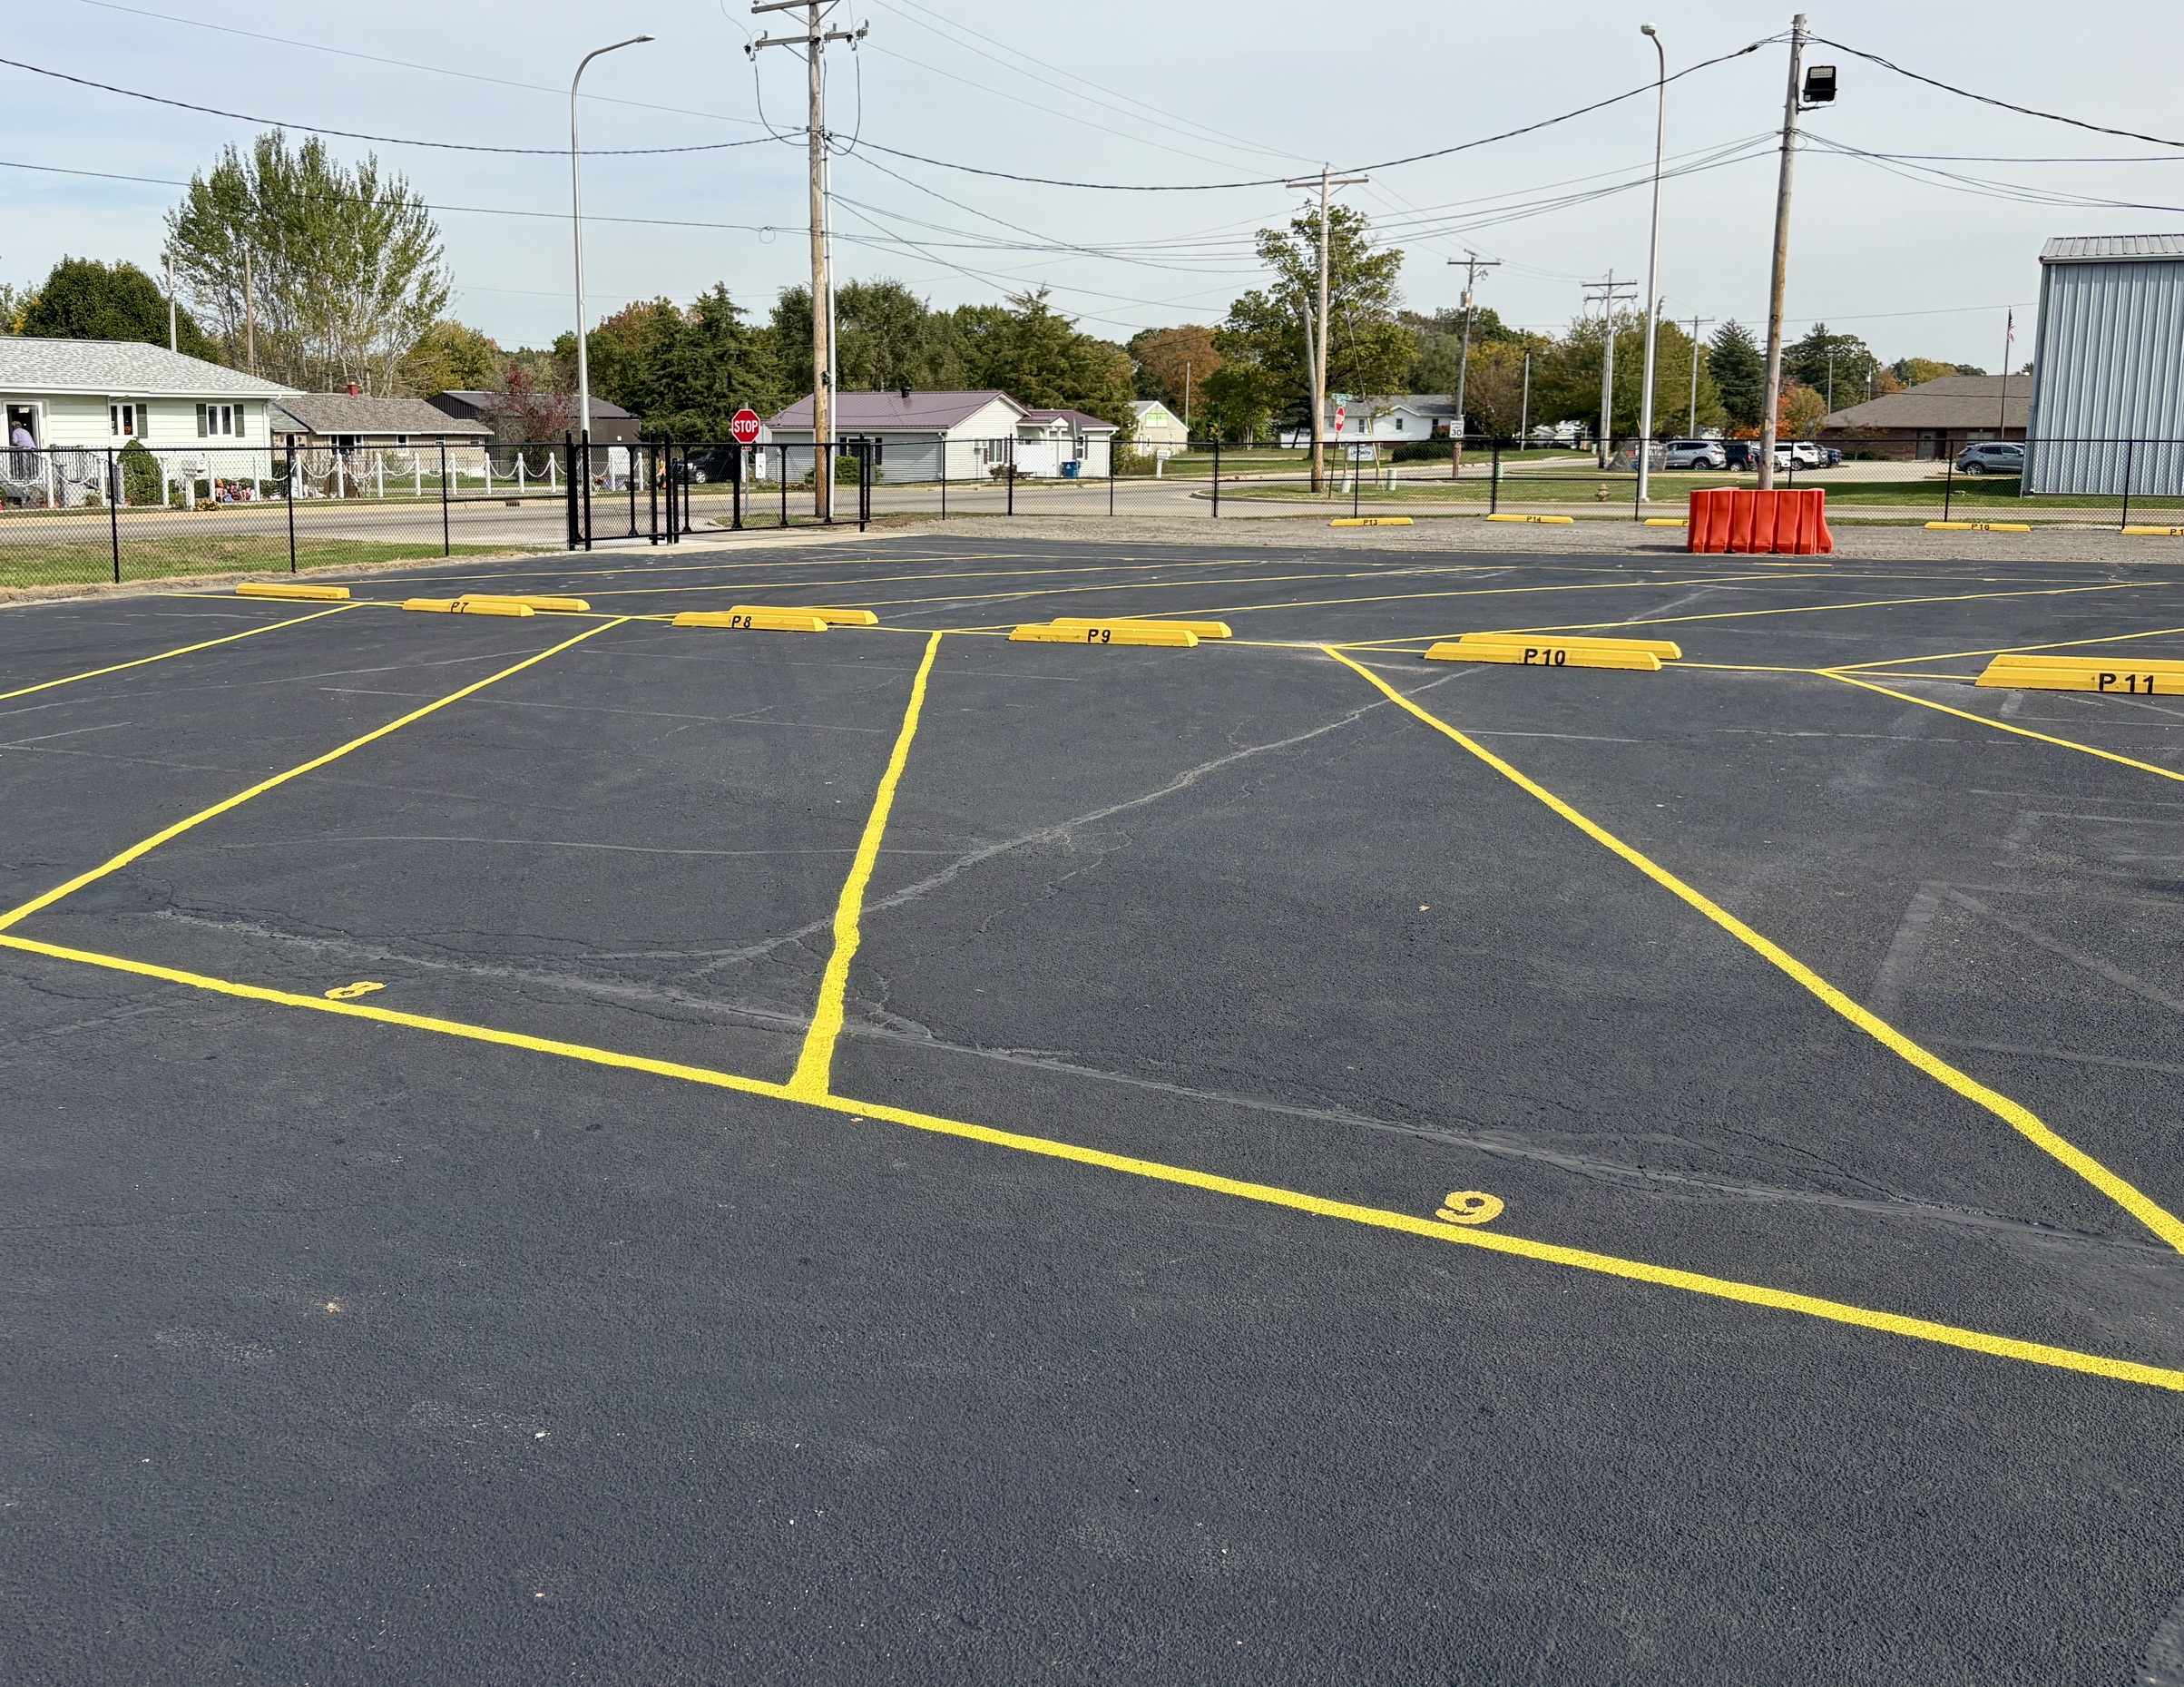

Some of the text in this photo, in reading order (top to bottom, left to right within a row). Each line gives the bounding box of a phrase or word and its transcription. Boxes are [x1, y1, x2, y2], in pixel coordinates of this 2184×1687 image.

[734, 420, 759, 433] STOP
[451, 602, 469, 613] P7
[731, 615, 751, 629] P8
[1087, 629, 1112, 643] P9
[1524, 648, 1566, 665] P10
[2099, 672, 2154, 694] P11
[324, 981, 387, 1000] 8
[1435, 1191, 1504, 1225] 9
